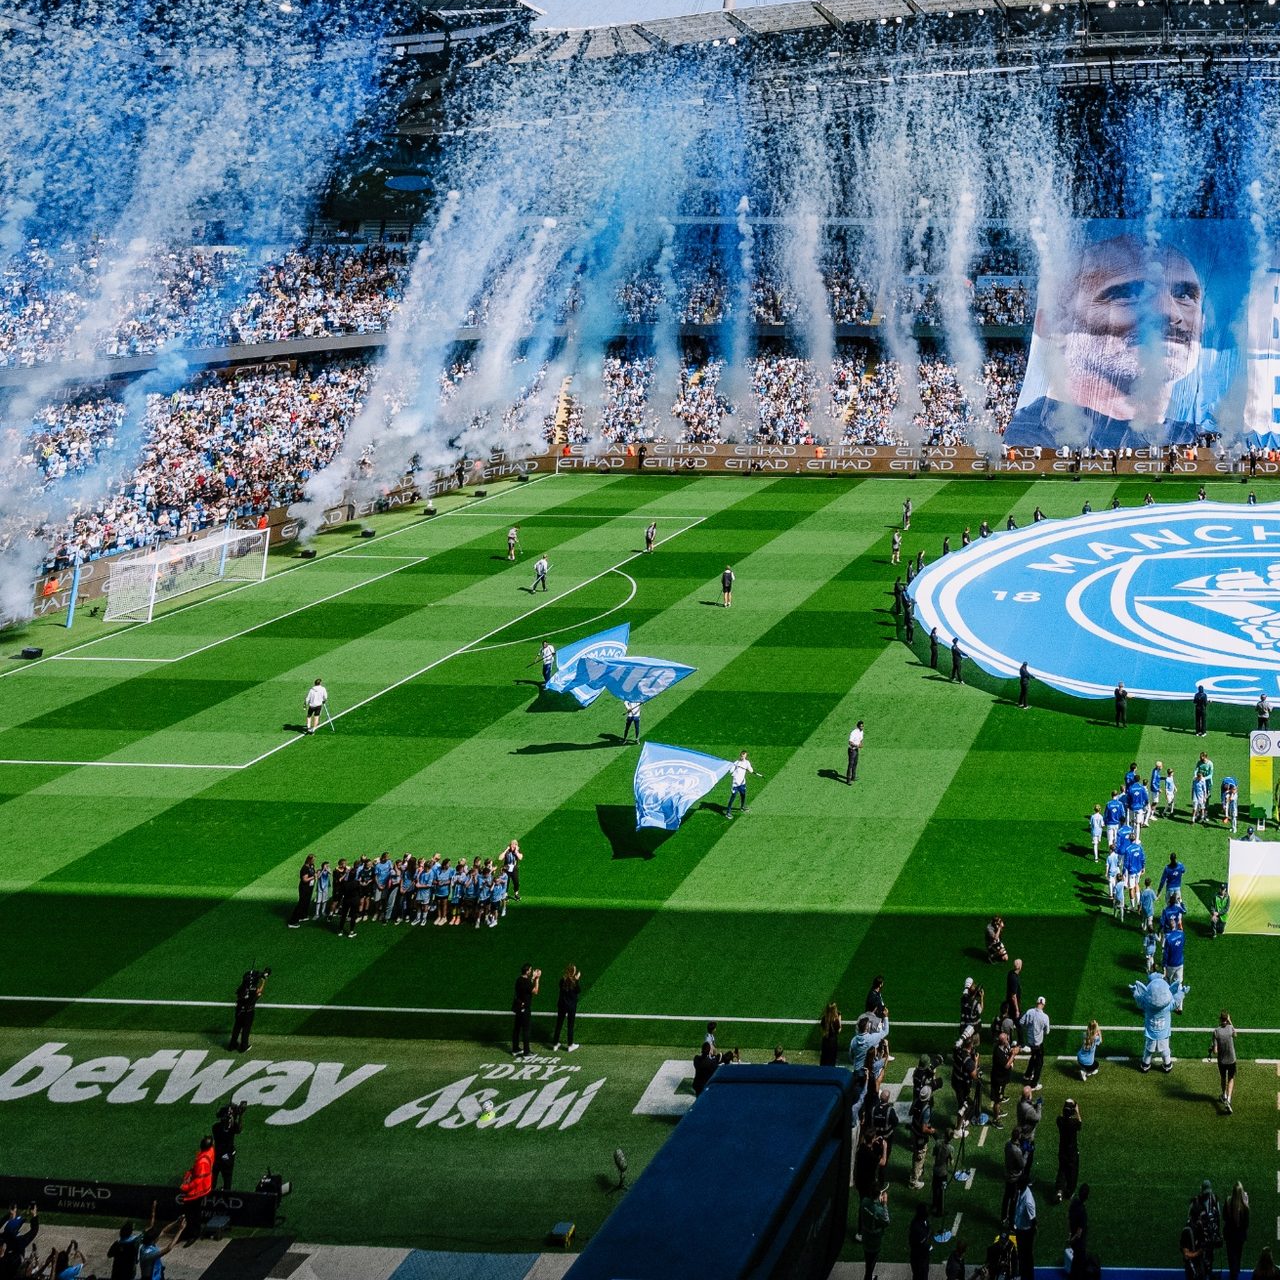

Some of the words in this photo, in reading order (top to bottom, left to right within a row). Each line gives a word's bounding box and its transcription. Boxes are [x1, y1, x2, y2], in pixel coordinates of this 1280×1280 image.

[653, 444, 717, 456] ETIHAD
[736, 445, 797, 456] ETIHAD
[895, 446, 958, 457] ETHAD
[558, 457, 625, 468] ETIHAD
[642, 457, 708, 468] ETIHAD
[806, 459, 872, 470] ETIHAD
[889, 460, 954, 470] ETIAD
[971, 461, 1035, 471] EIHAD
[1053, 461, 1113, 472] ETHAD
[358, 491, 414, 515] ETAD
[482, 460, 538, 480] ETIHAD
[993, 589, 1041, 603] 18
[0, 1041, 387, 1126] betway
[384, 1073, 607, 1131] Asahi
[44, 1184, 112, 1200] ETIHAD
[57, 1199, 96, 1210] AIRWAYS
[175, 1193, 243, 1209] EHAD
